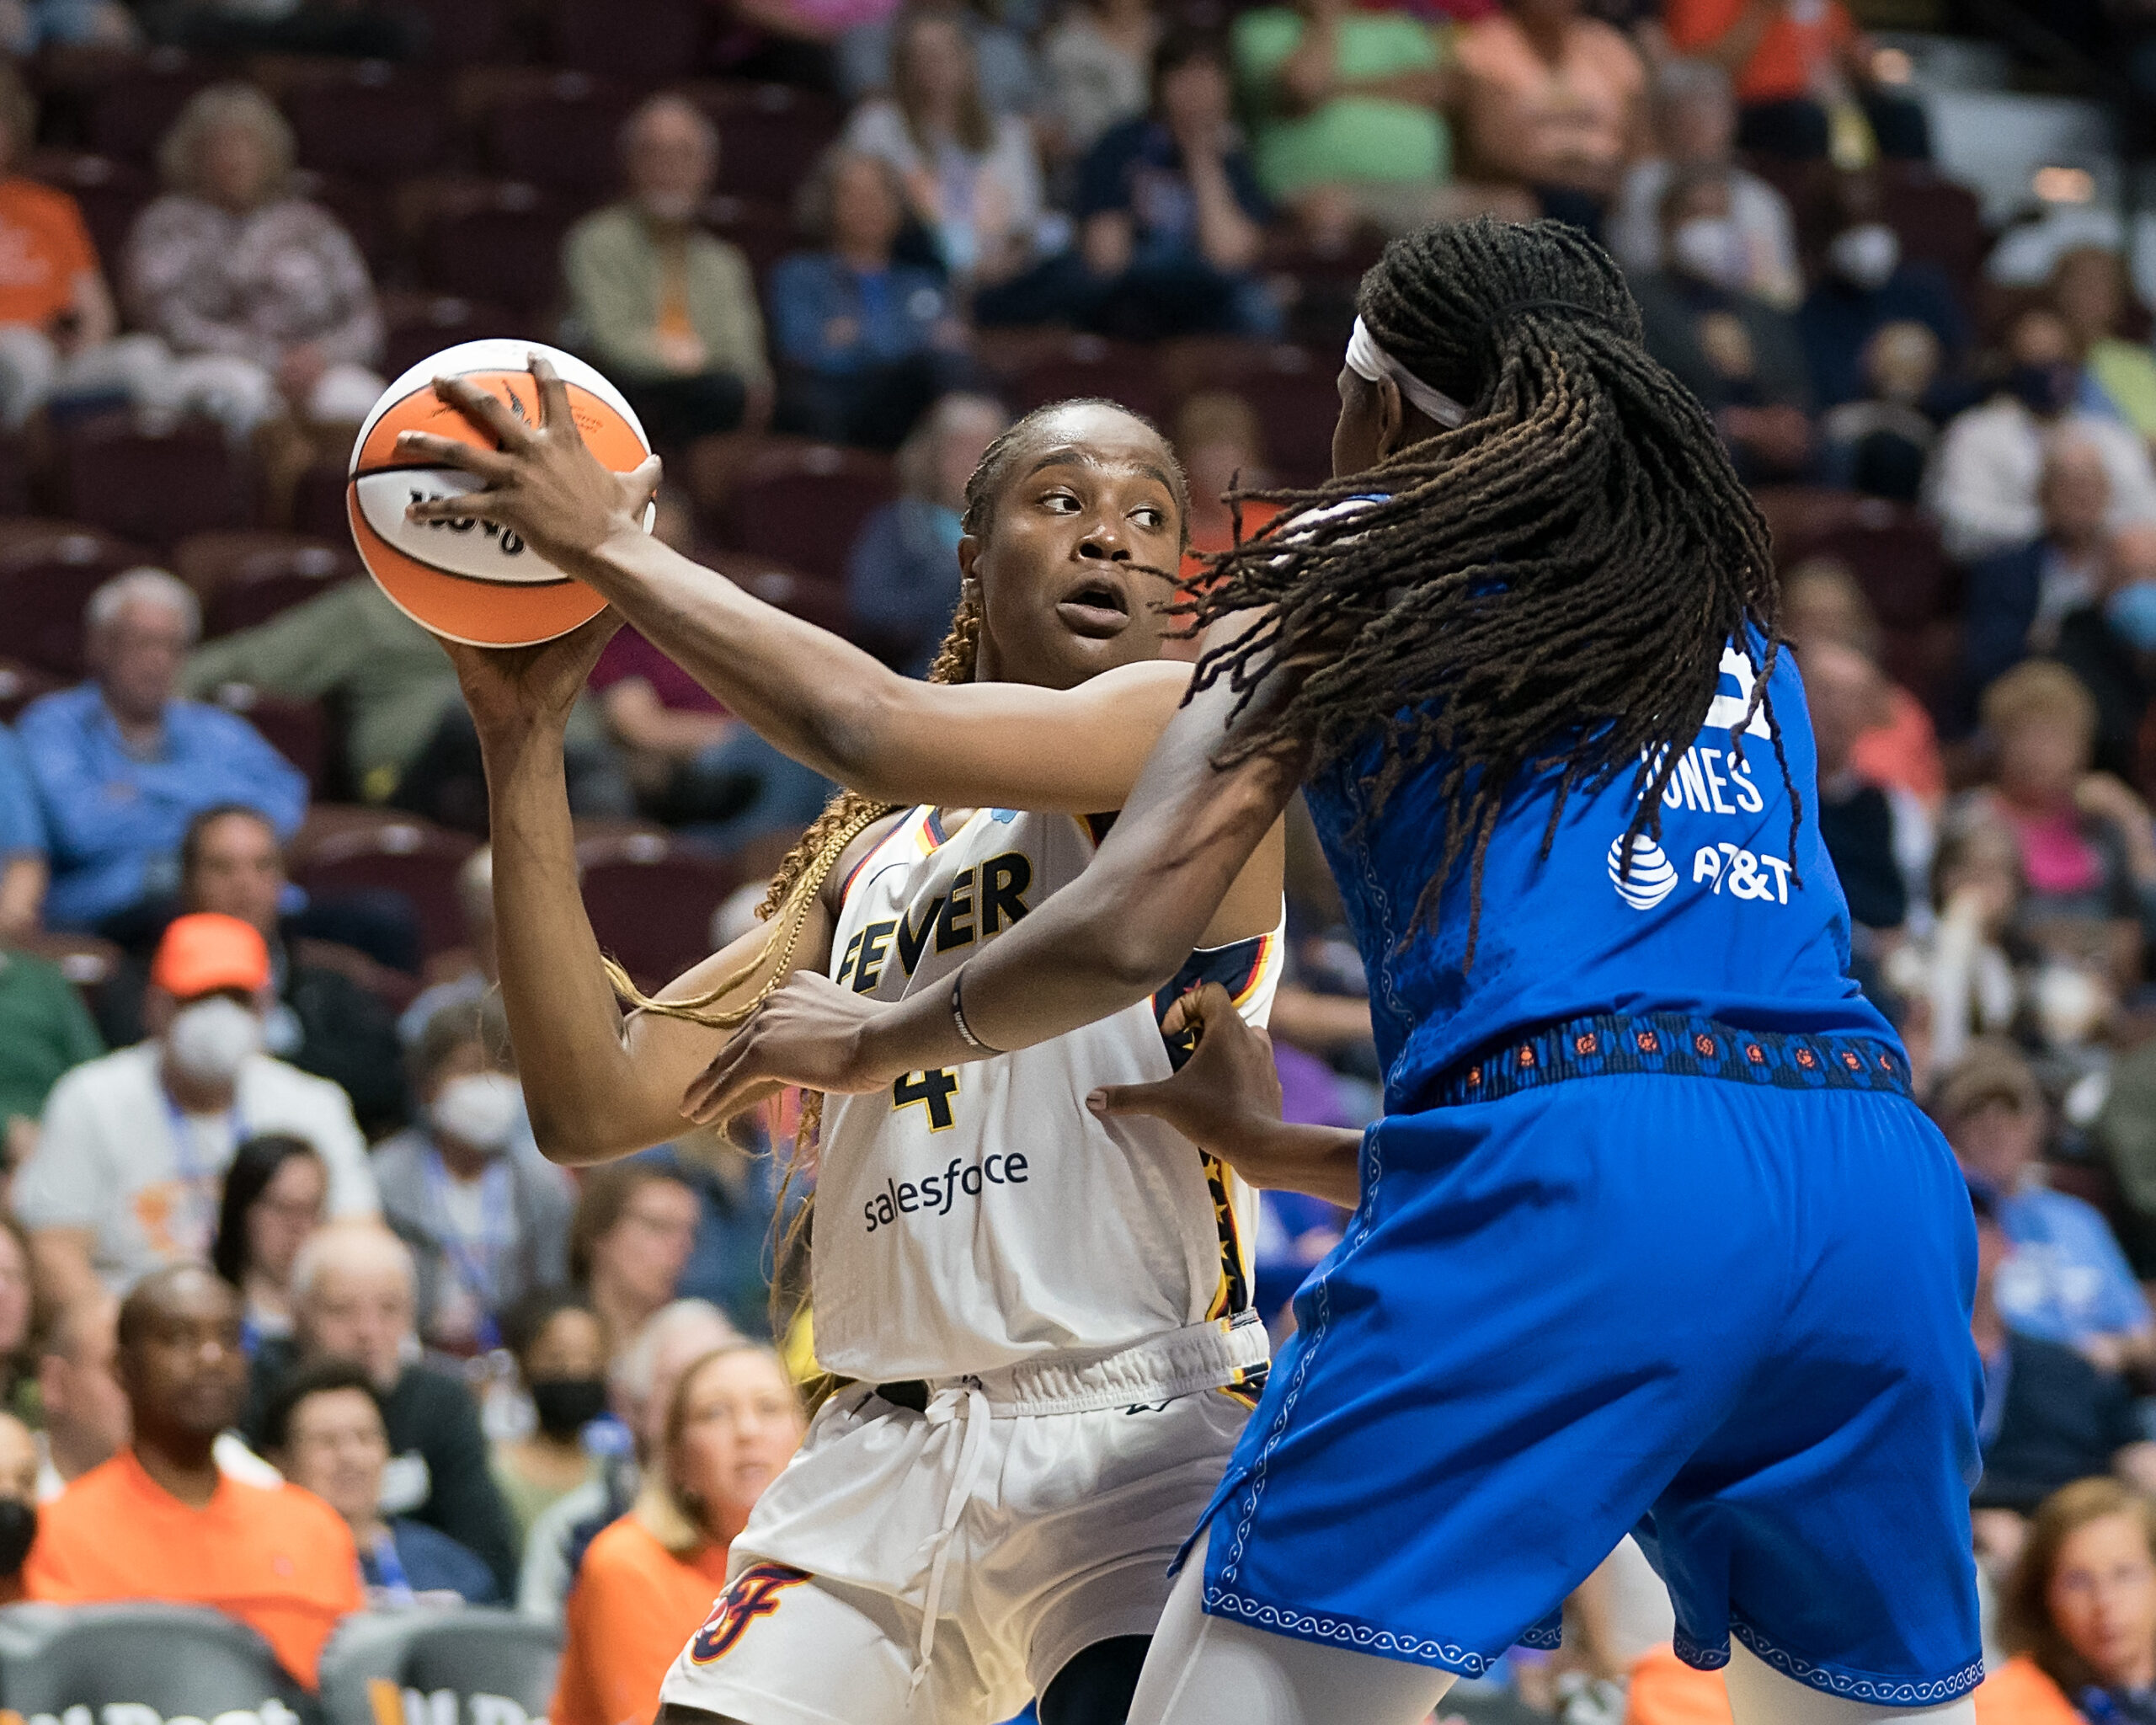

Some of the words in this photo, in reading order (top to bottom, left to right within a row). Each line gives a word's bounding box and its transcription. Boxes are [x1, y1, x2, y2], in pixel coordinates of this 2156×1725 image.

[1693, 842, 1792, 905] AT&T
[836, 850, 1033, 996] FEVER
[892, 1068, 960, 1133] 4
[864, 1152, 1028, 1232] salesfoce
